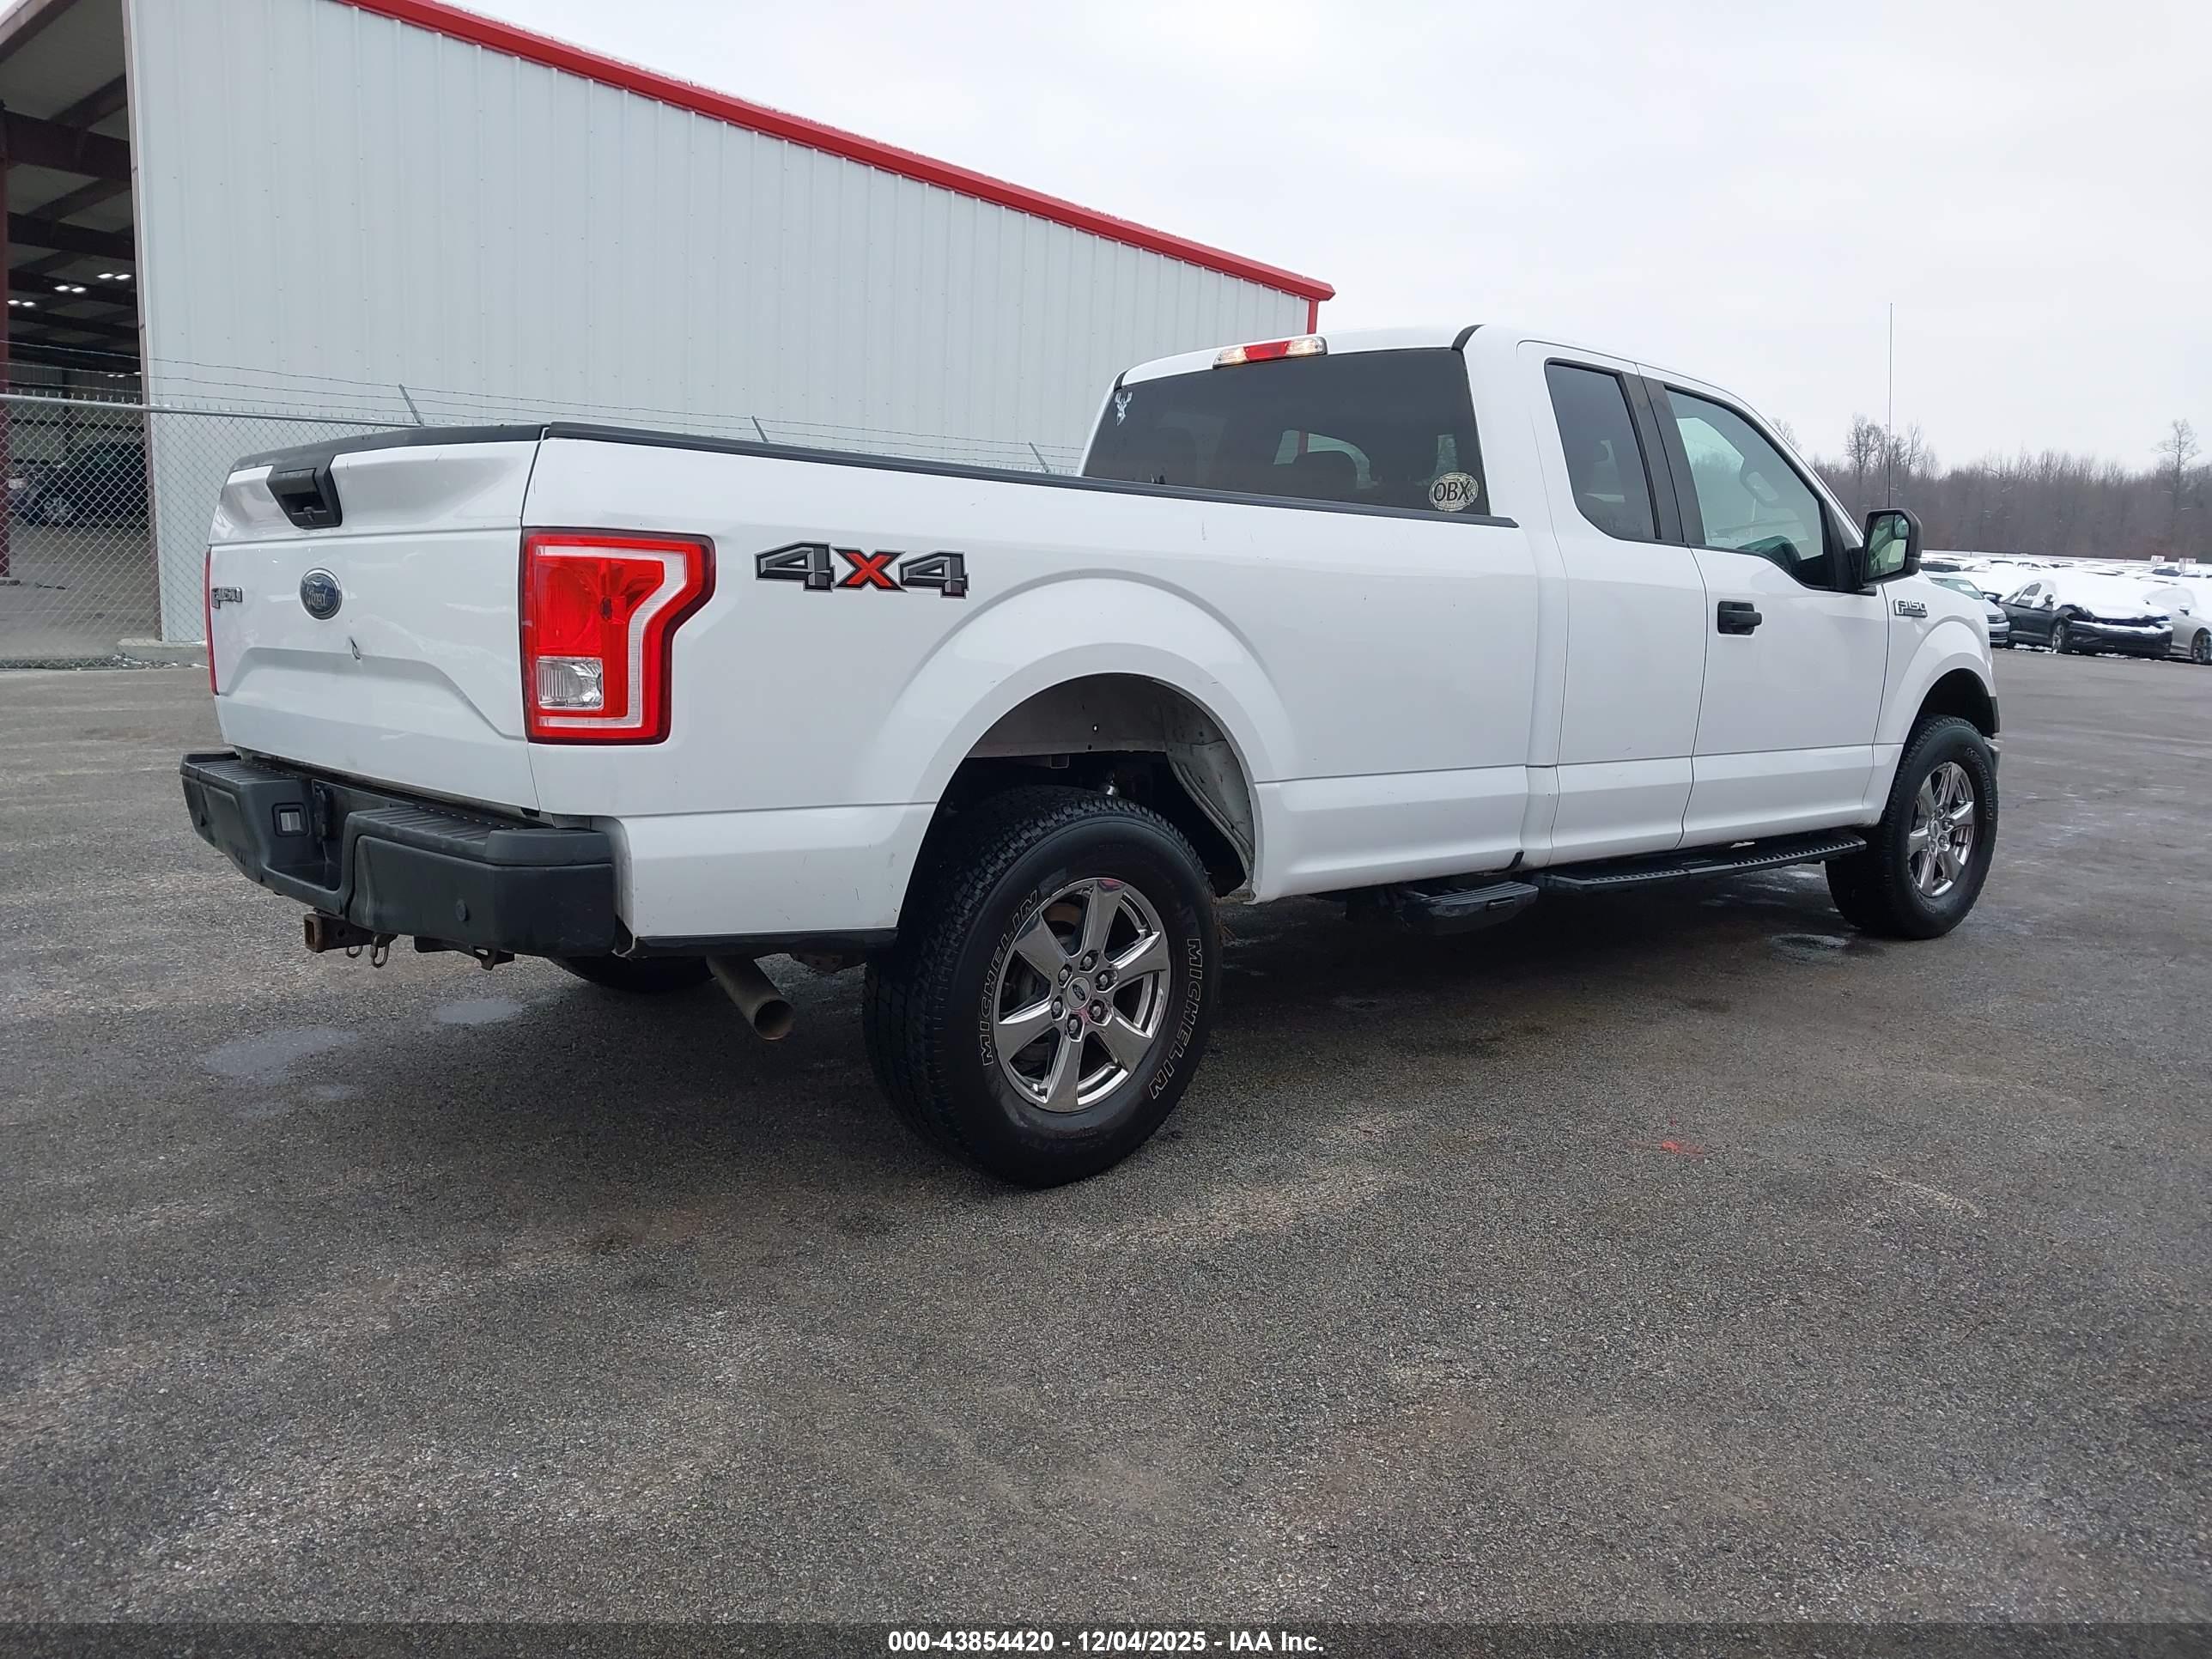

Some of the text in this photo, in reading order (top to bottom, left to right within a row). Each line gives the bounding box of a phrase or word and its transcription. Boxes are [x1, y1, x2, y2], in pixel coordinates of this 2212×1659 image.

[1434, 481, 1471, 502] OBX
[978, 890, 1038, 1066] MICHELIN
[1148, 938, 1203, 1100] MICHELIN
